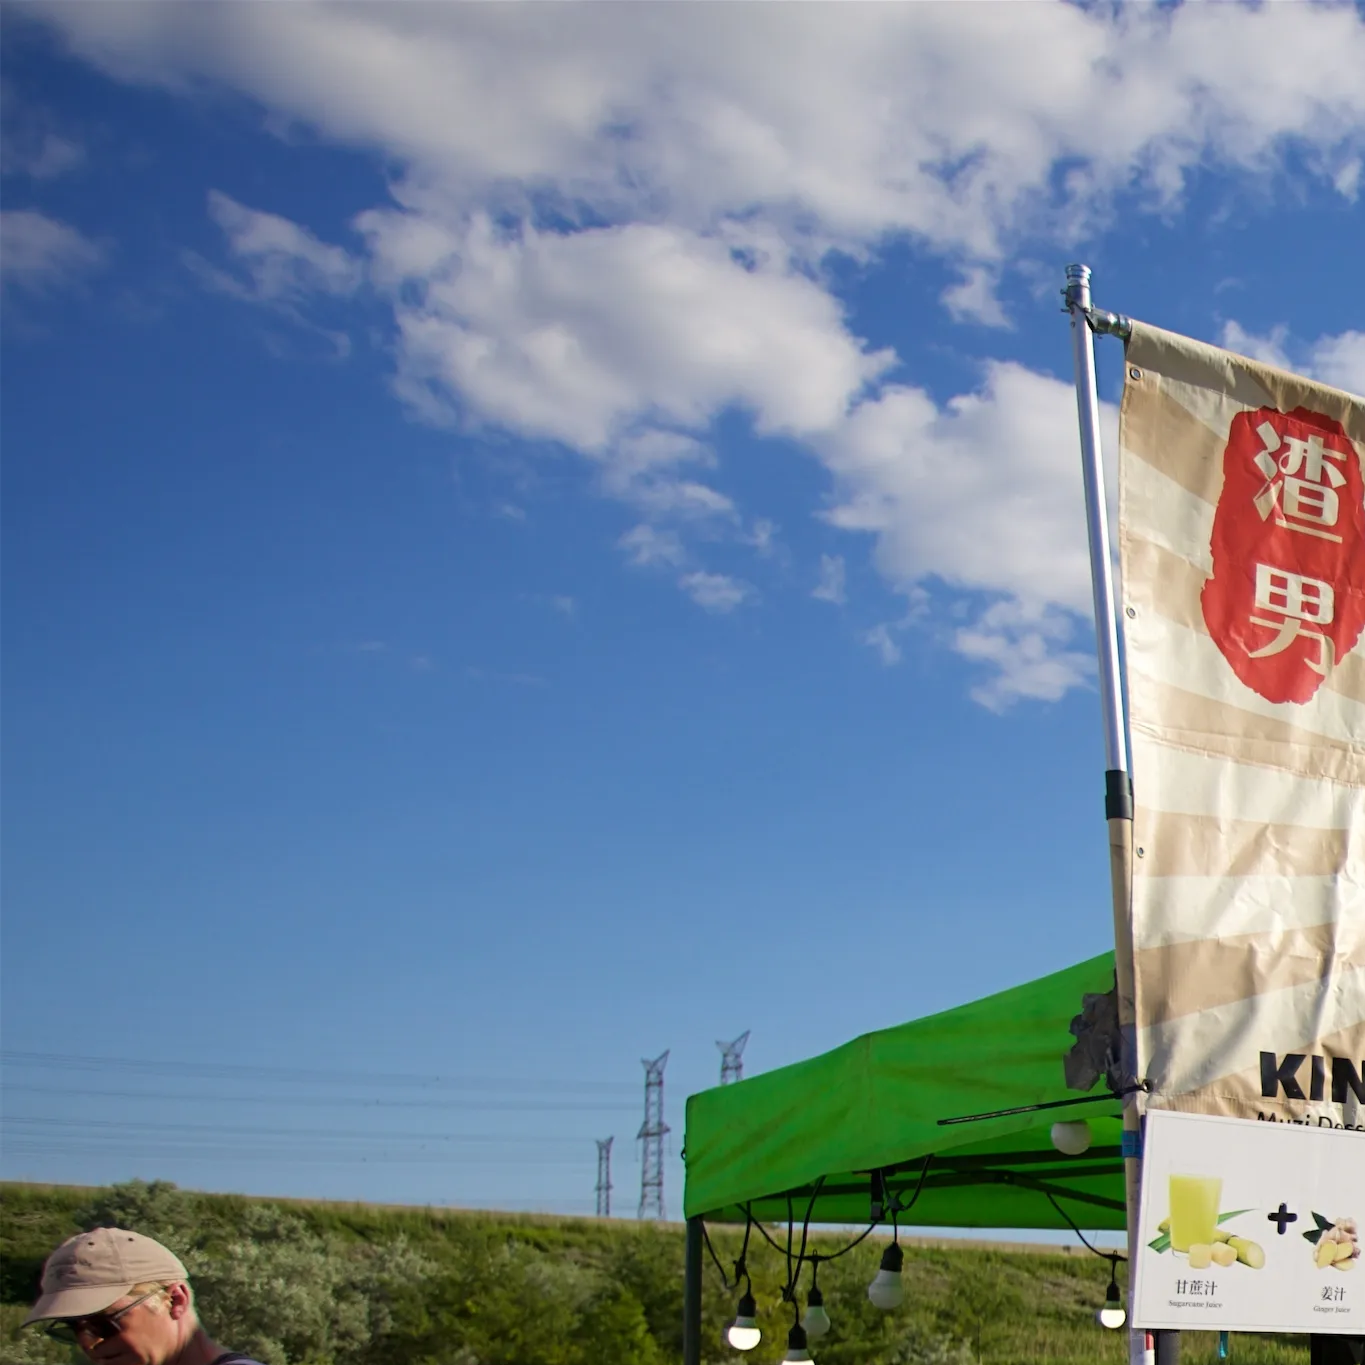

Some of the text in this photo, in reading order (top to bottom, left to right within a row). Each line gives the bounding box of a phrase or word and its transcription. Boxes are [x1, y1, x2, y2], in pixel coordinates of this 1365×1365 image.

[1248, 419, 1348, 677] 渣男
[1176, 1279, 1218, 1296] 甘蔗汁
[1321, 1285, 1347, 1301] 姜汁
[1168, 1300, 1224, 1309] Sugarcane Juice
[1313, 1305, 1351, 1314] Ginger Juice
